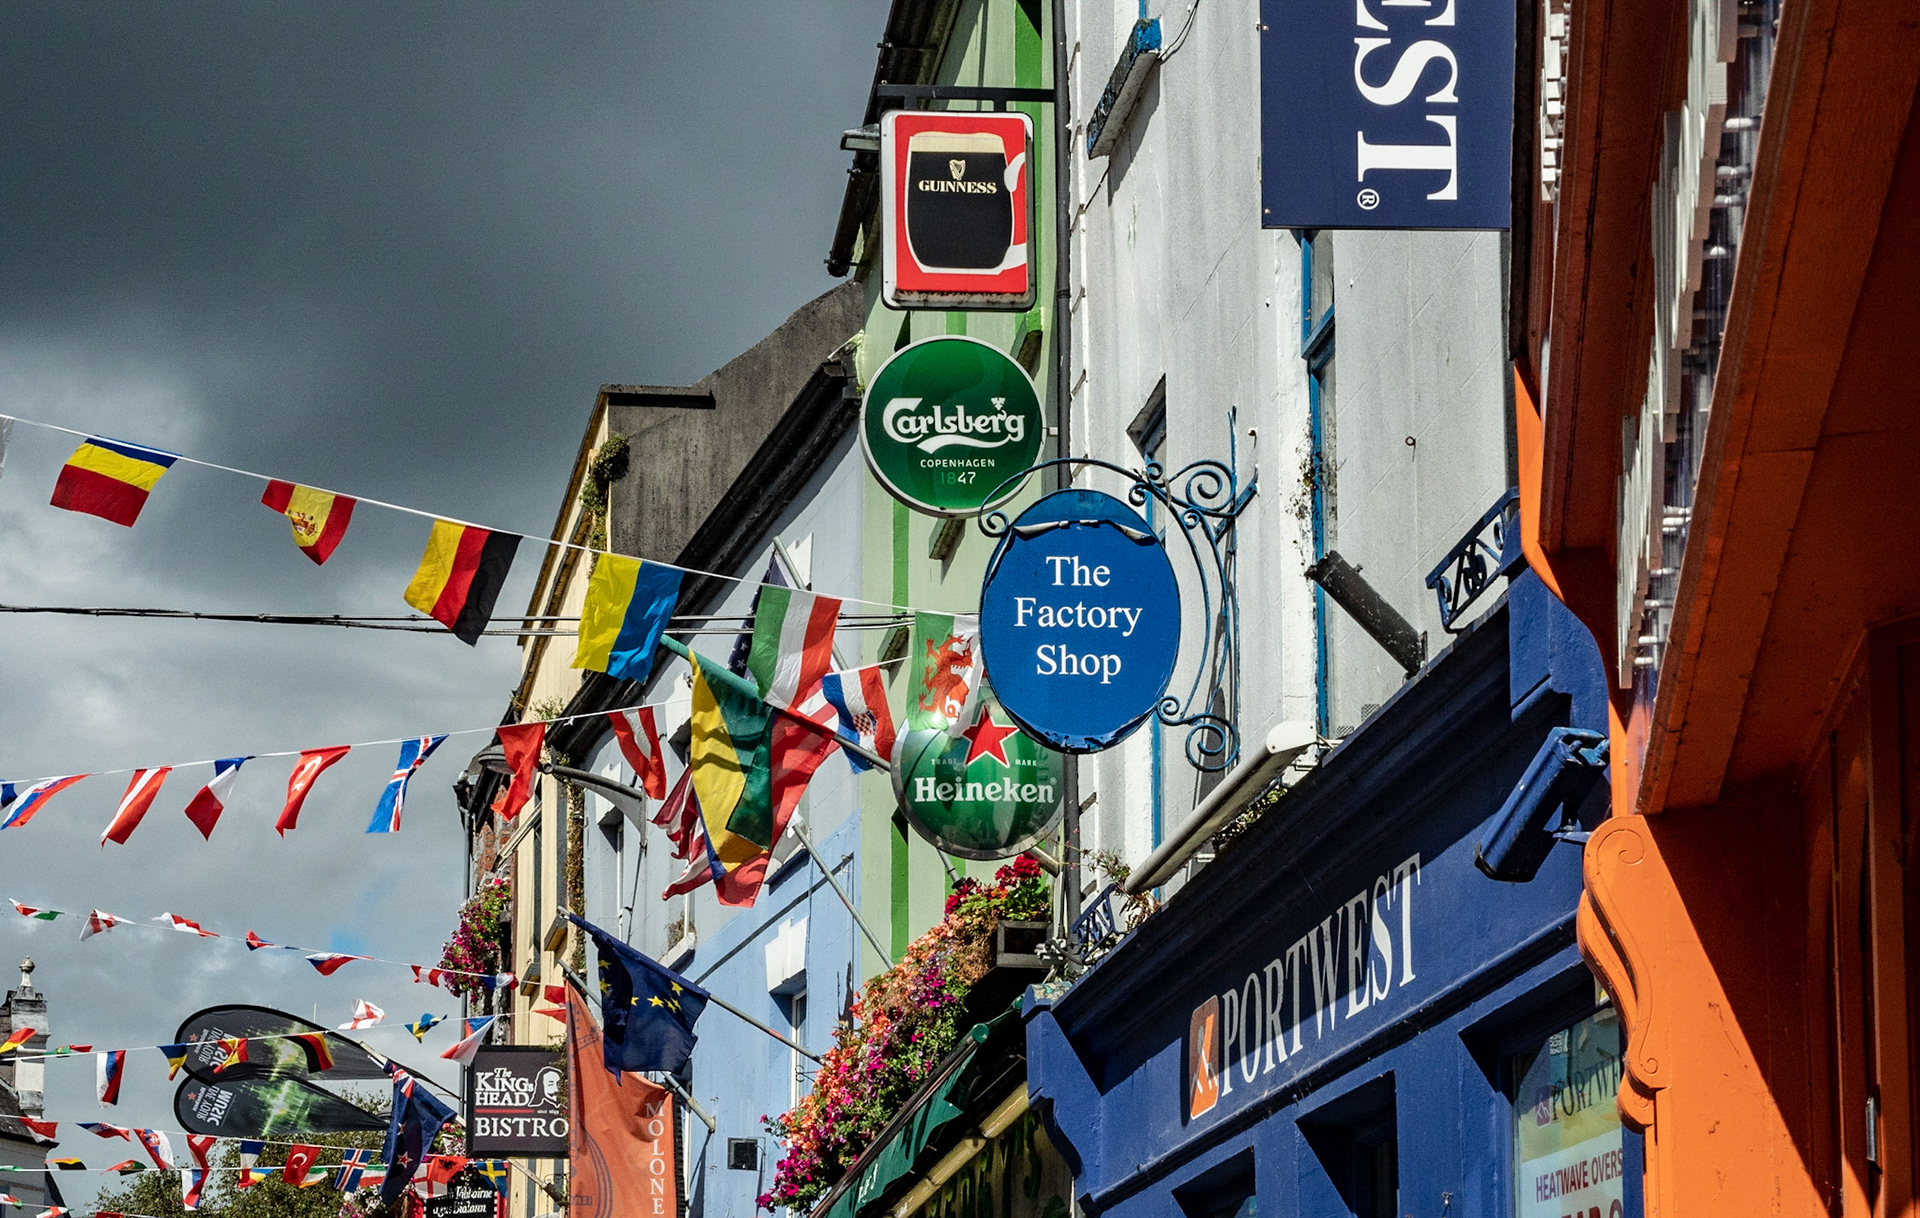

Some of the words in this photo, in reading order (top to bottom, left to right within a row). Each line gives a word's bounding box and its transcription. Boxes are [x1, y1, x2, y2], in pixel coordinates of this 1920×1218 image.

[918, 180, 998, 194] GUINNESS
[882, 397, 1026, 443] Carlsberg
[920, 458, 995, 467] COPENHAGEN
[940, 471, 976, 485] 1847
[1045, 555, 1111, 587] The
[1013, 597, 1143, 637] Factory
[1036, 644, 1122, 684] Shop
[1015, 758, 1038, 767] MARK
[1221, 852, 1421, 1097] PORTWEST
[494, 1067, 512, 1078] The
[475, 1092, 530, 1106] HEAD
[475, 1117, 569, 1138] BISTRO
[1535, 1160, 1589, 1203] HEATWAVE
